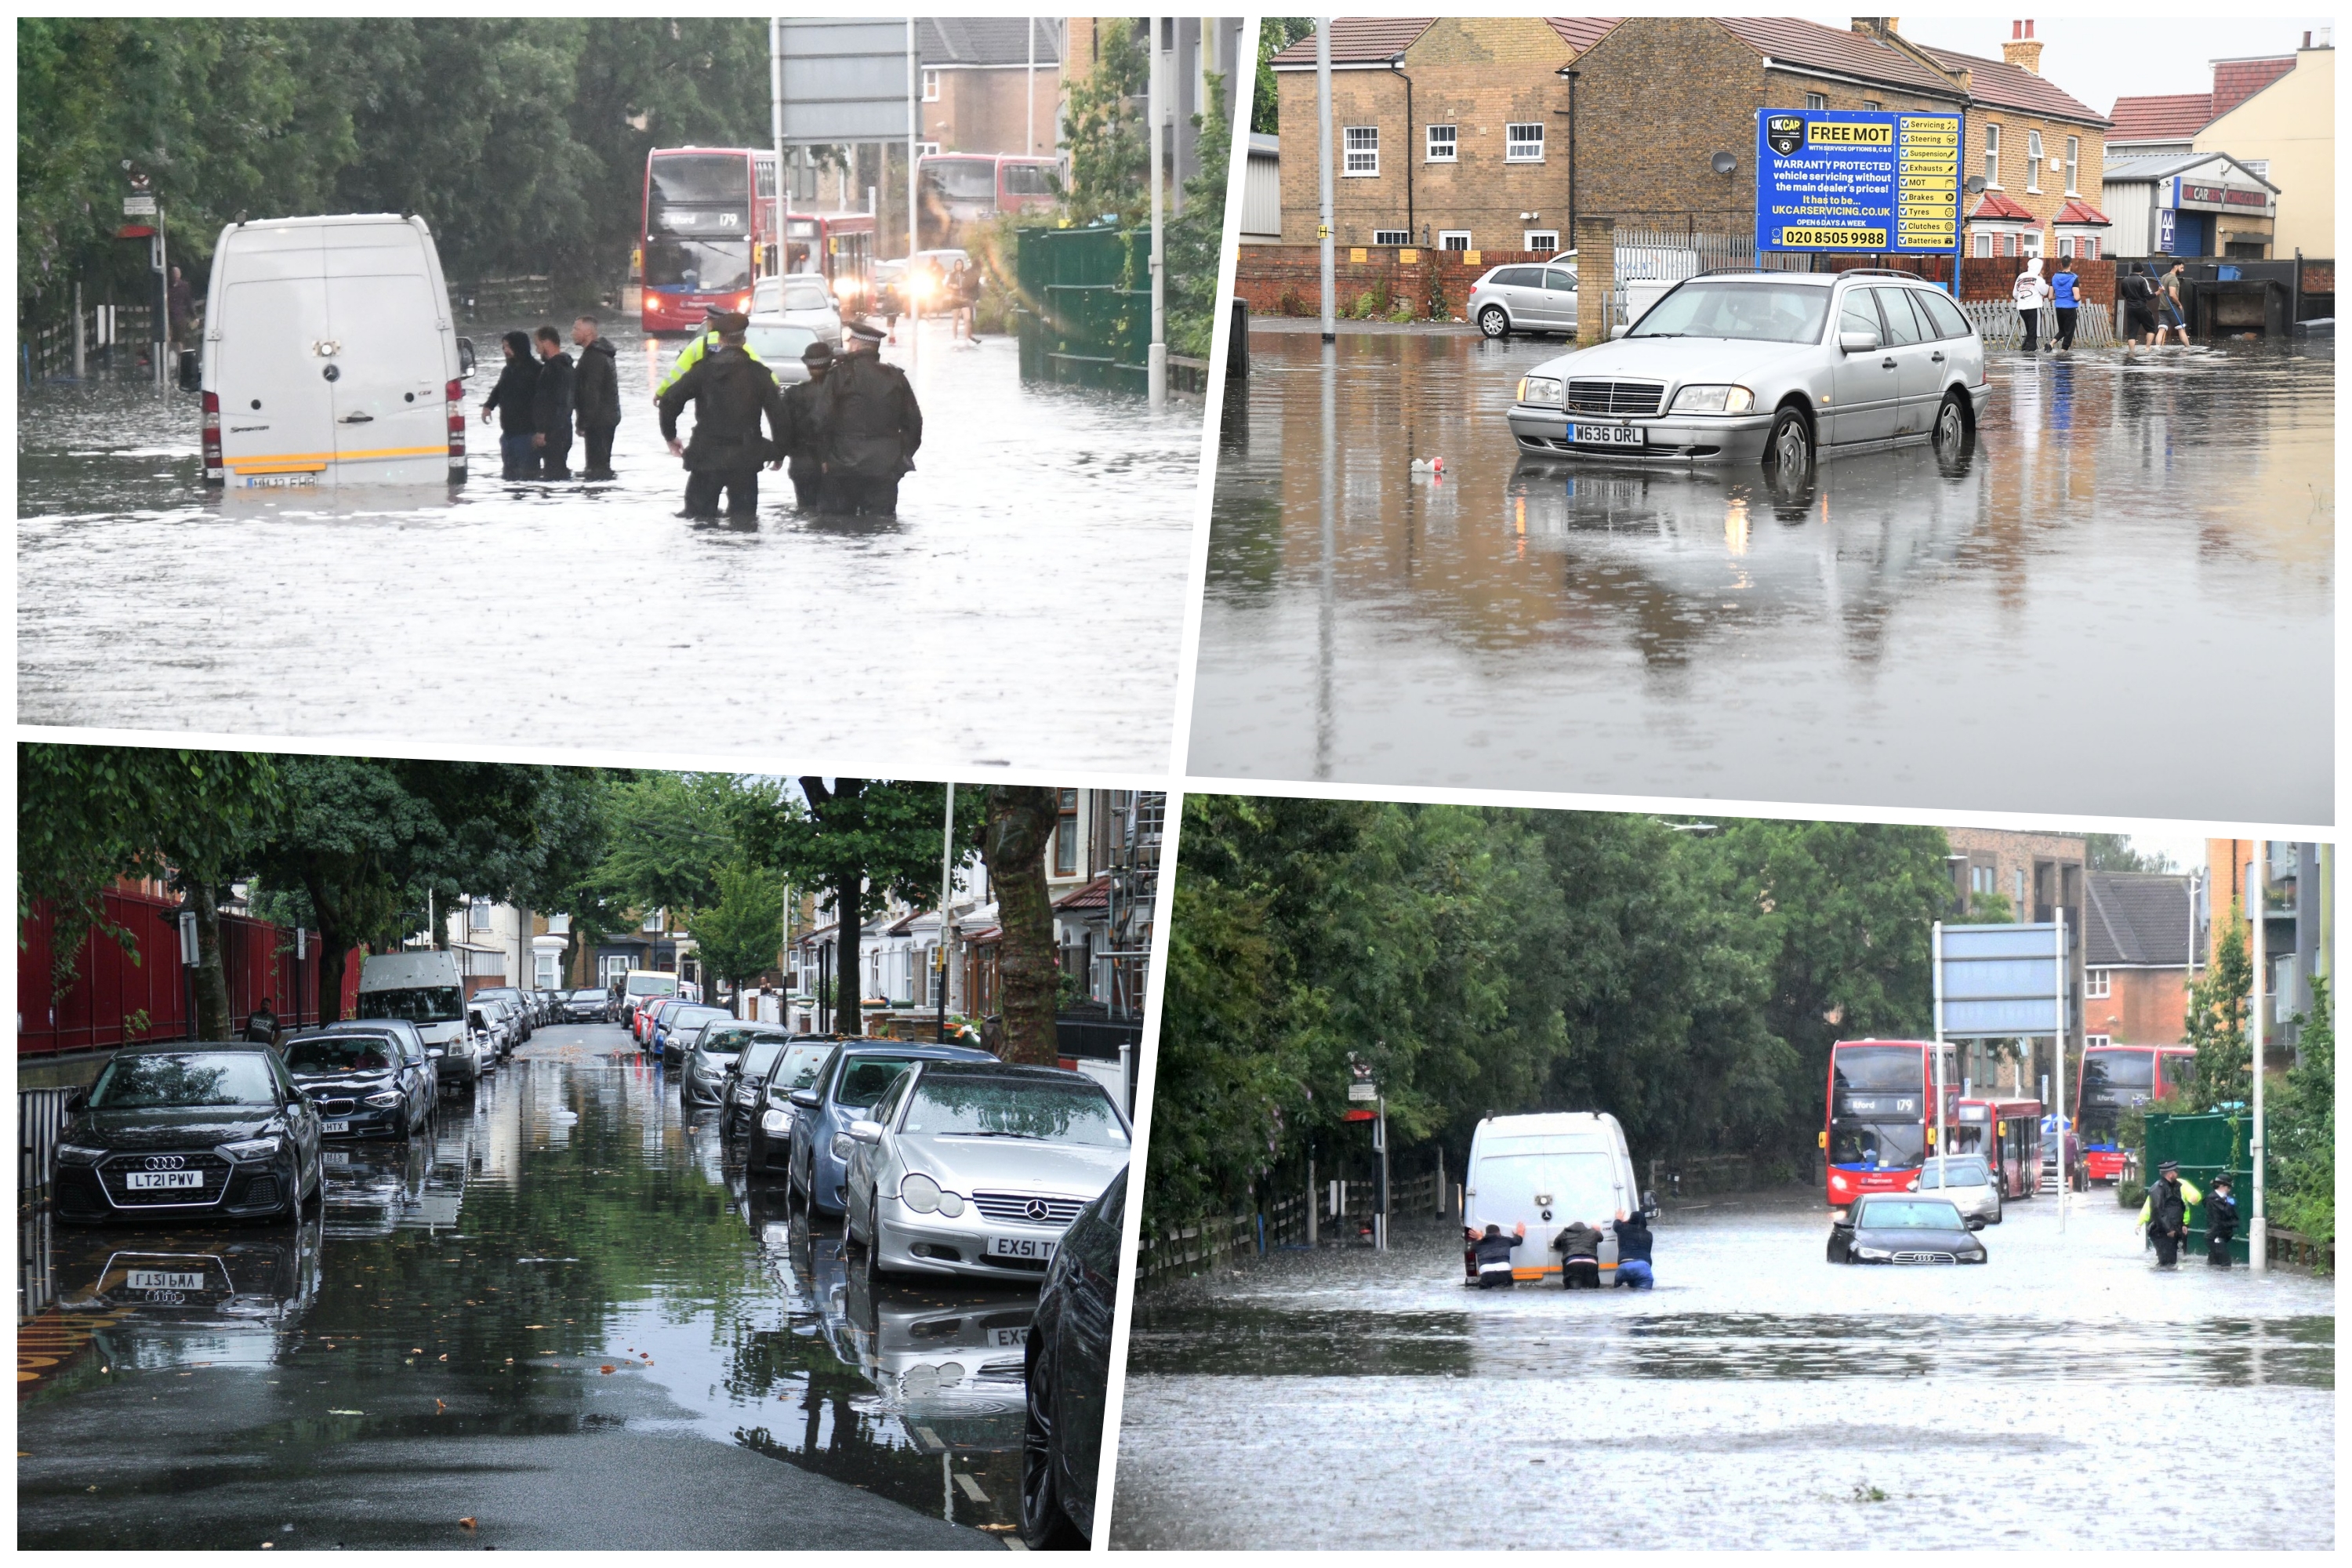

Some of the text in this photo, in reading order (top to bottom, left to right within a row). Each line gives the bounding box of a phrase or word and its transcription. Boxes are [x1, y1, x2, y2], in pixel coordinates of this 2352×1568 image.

[1911, 121, 1945, 129] Servicing
[1811, 126, 1889, 141] FREE MOT
[1773, 160, 1892, 171] WARRANTY PROTECTED
[1773, 171, 1891, 183] vehicle servicing without
[1776, 182, 1889, 194] the main dealer's prices!
[1803, 195, 1809, 204] It
[1811, 195, 1828, 204] has
[1842, 196, 1861, 205] be...
[1772, 205, 1890, 216] UKCARSERVICING.CO.UK
[720, 213, 737, 226] 179
[1787, 231, 1884, 244] 020 8505 9988
[1577, 426, 1641, 443] W636 ORL
[1897, 1099, 1912, 1111] 179
[136, 1173, 194, 1187] LT21 PWV
[997, 1239, 1036, 1256] EX51
